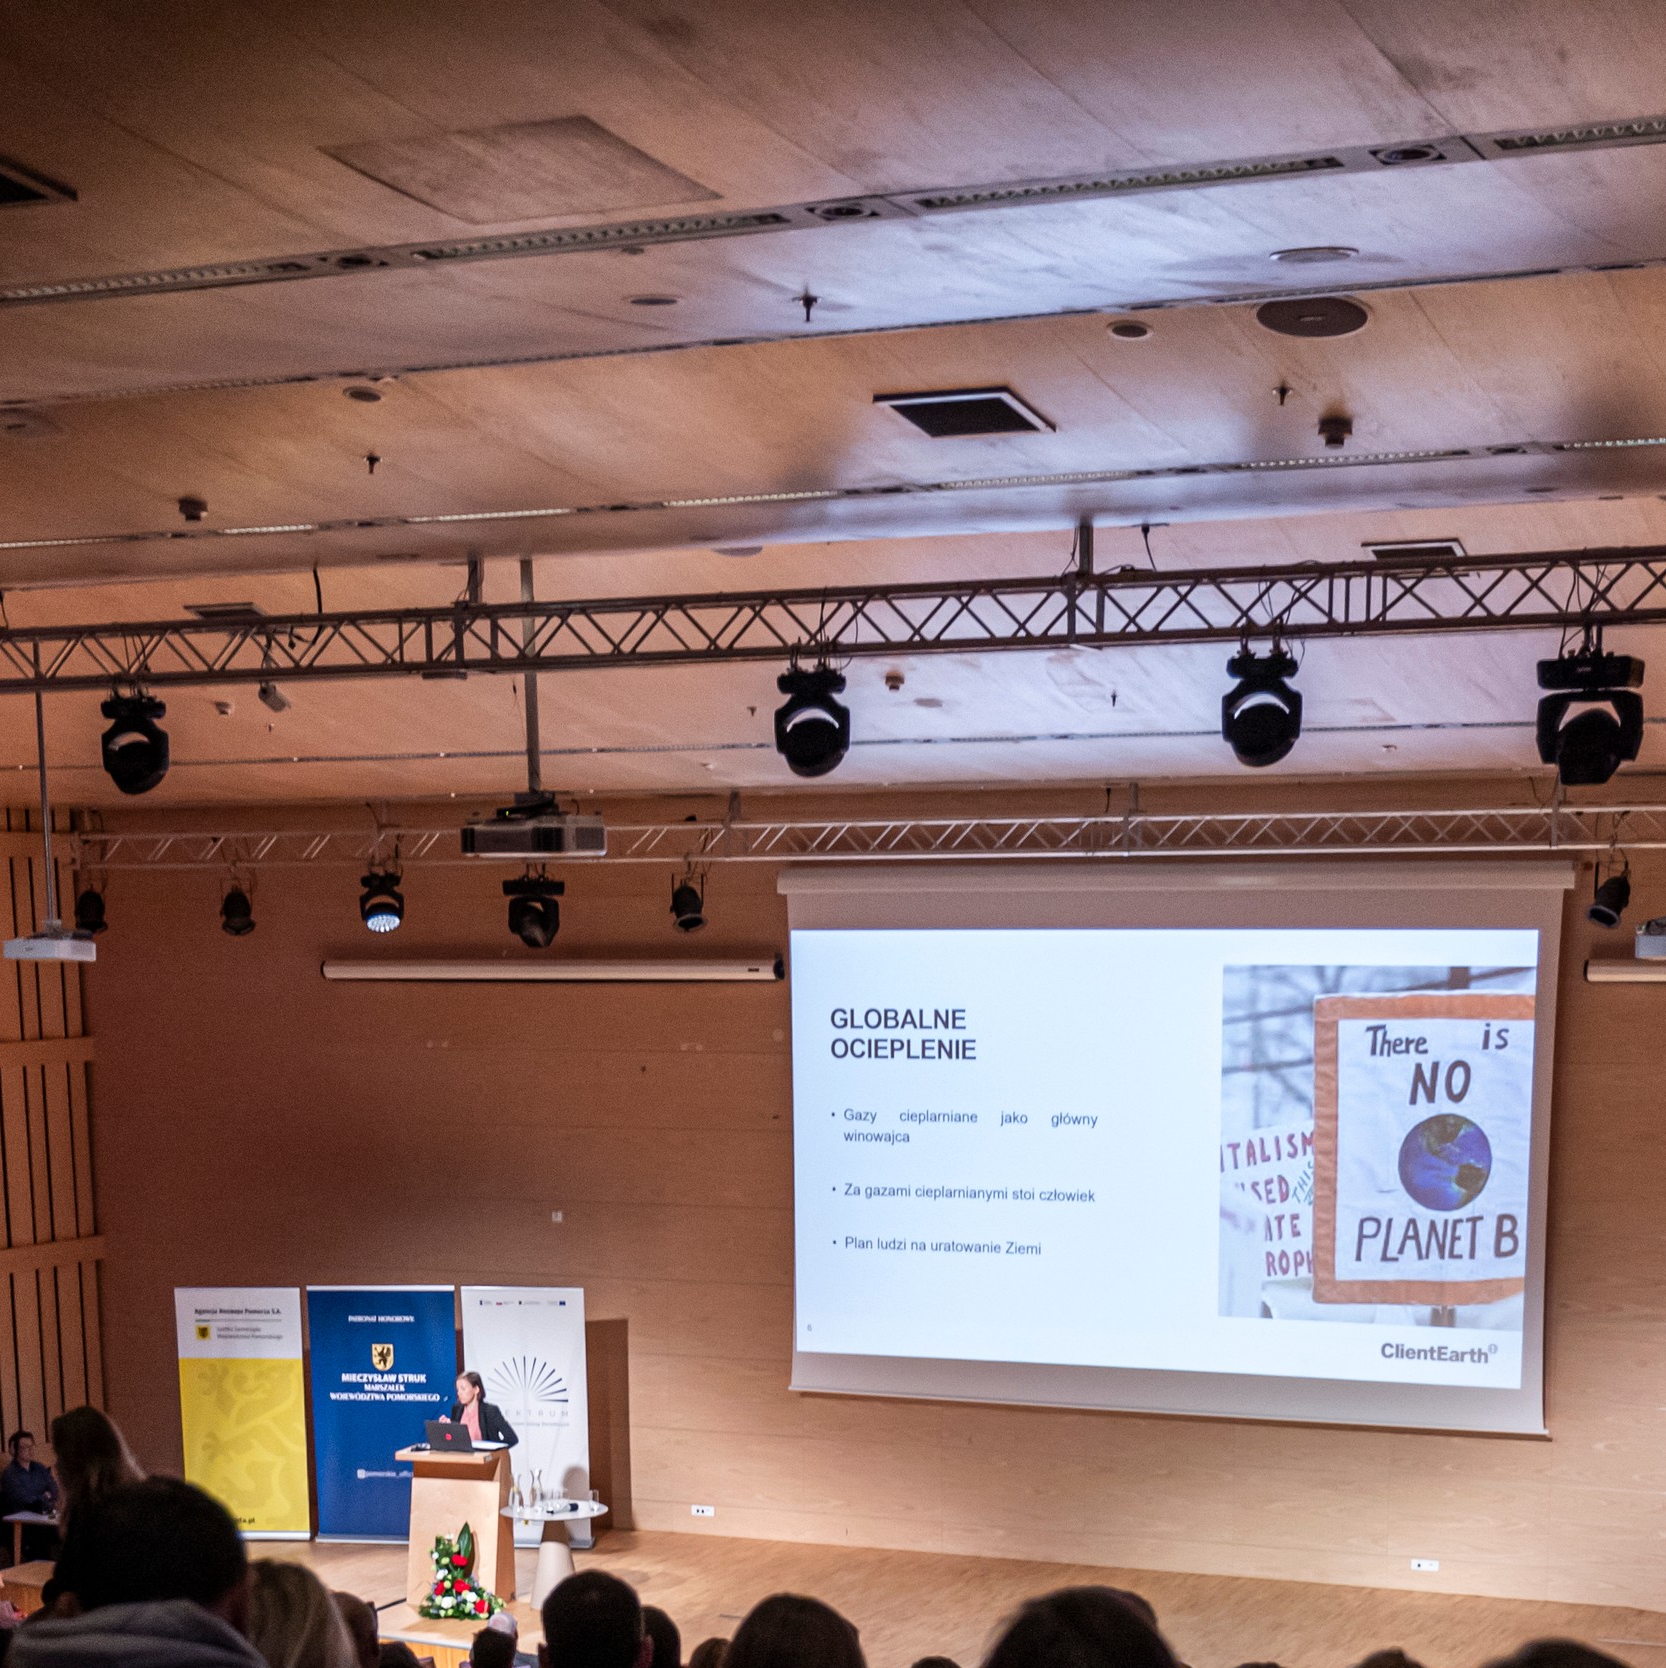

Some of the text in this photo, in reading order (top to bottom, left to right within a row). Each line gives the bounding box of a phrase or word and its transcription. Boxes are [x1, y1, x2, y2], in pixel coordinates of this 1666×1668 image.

[830, 1007, 967, 1030] GLOBALNE
[830, 1037, 977, 1060] OCIEPLENIE
[1365, 1023, 1510, 1057] There is
[1408, 1059, 1472, 1105] NO
[843, 1108, 1098, 1128] Gazy cieplarniane jako główny
[843, 1129, 910, 1146] winowajca
[844, 1183, 1095, 1202] Za gazami cieplarnianymi stoi człowiek
[1264, 1213, 1302, 1242] ATE
[1355, 1213, 1520, 1262] PLANET B
[844, 1236, 1041, 1255] Plan ludzi na uratowanie Ziemi
[1380, 1342, 1489, 1364] ClientEarth
[341, 1373, 427, 1383] MIECZYSŁAW STRUK
[504, 1408, 569, 1417] EKTRUM
